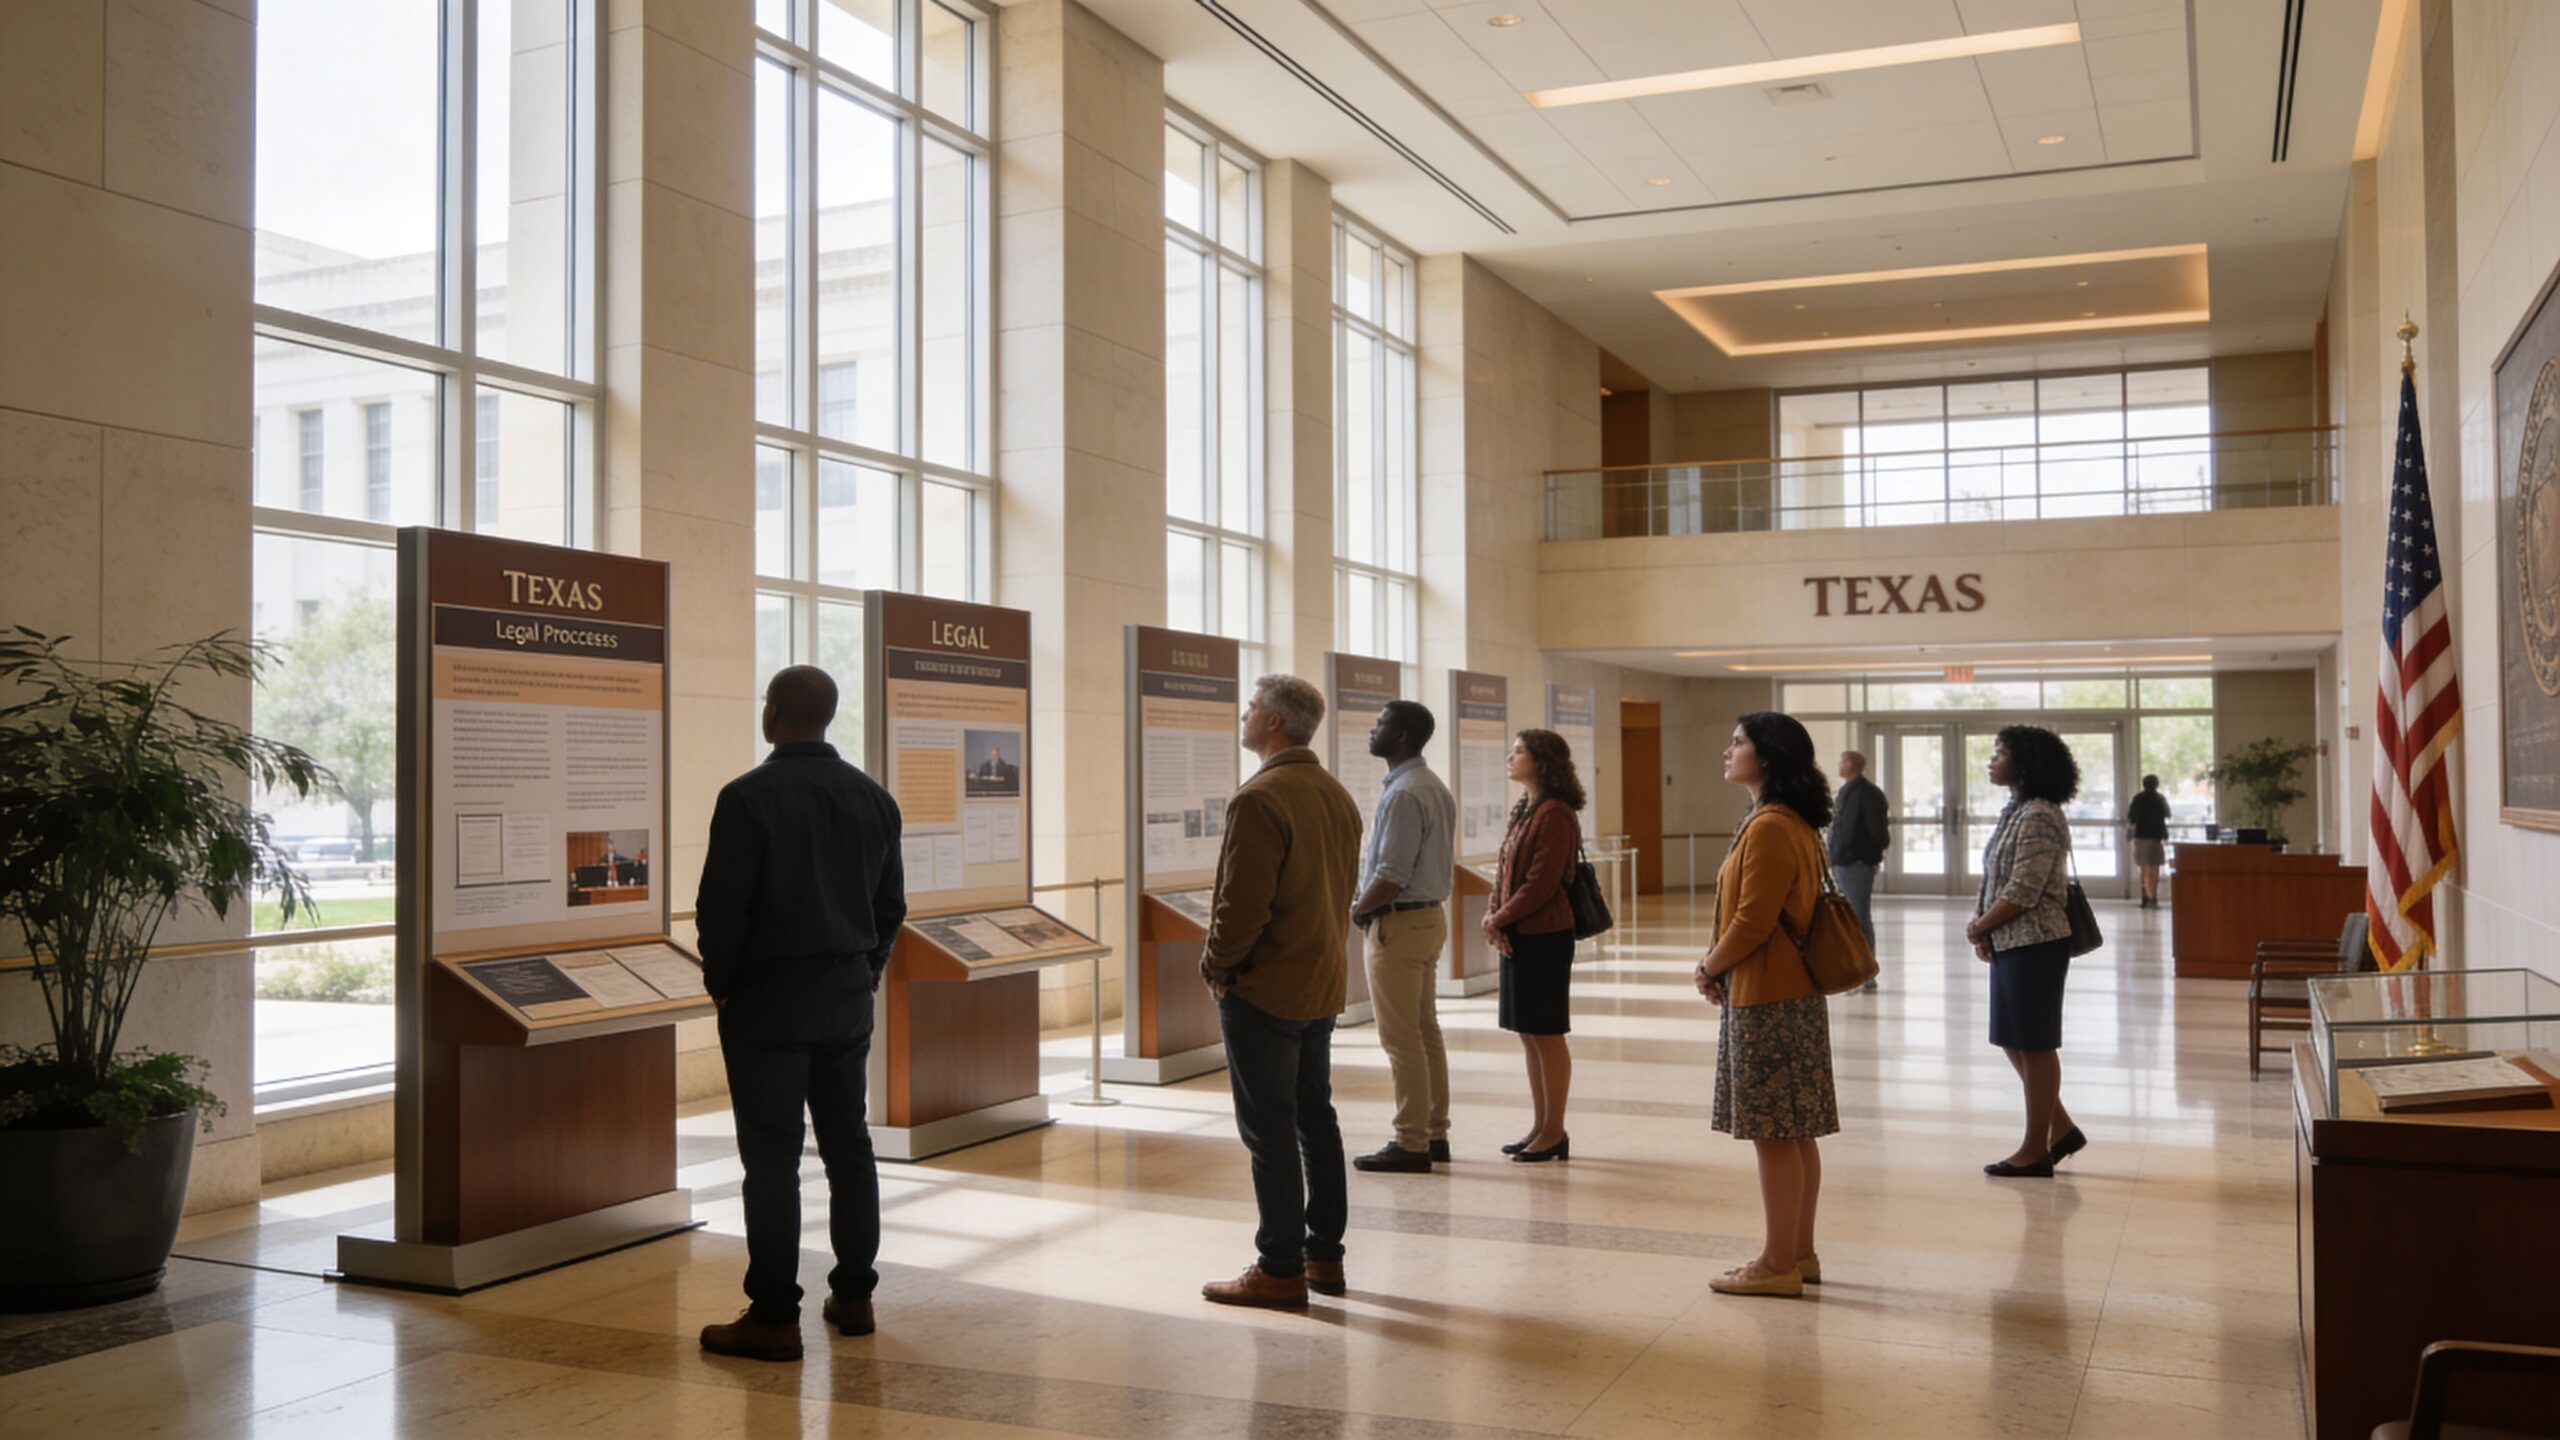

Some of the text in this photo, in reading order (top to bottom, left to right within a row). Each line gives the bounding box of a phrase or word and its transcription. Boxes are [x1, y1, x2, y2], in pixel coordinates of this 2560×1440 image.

[503, 569, 603, 611] TEXAS
[1803, 573, 1986, 617] TEXAS
[496, 619, 539, 645] Legal
[932, 620, 990, 649] LEGAL
